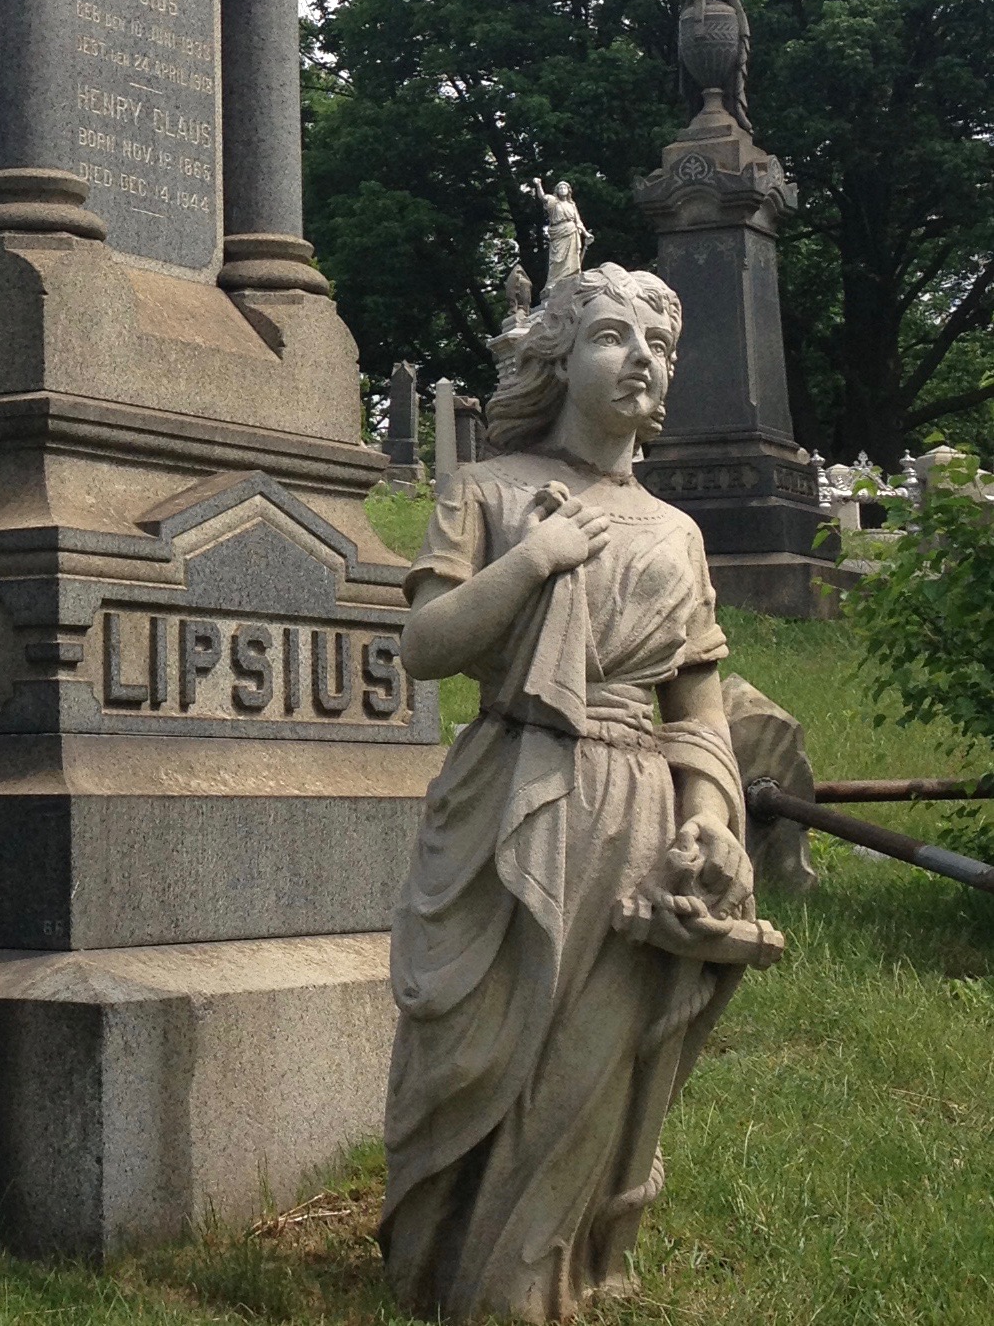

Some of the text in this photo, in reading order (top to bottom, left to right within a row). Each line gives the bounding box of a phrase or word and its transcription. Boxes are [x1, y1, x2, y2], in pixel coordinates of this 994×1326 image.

[77, 79, 212, 148] HENRY CLAUS
[78, 126, 116, 154] BORN
[78, 161, 112, 187] DIED
[104, 610, 402, 721] LIPSIUS
